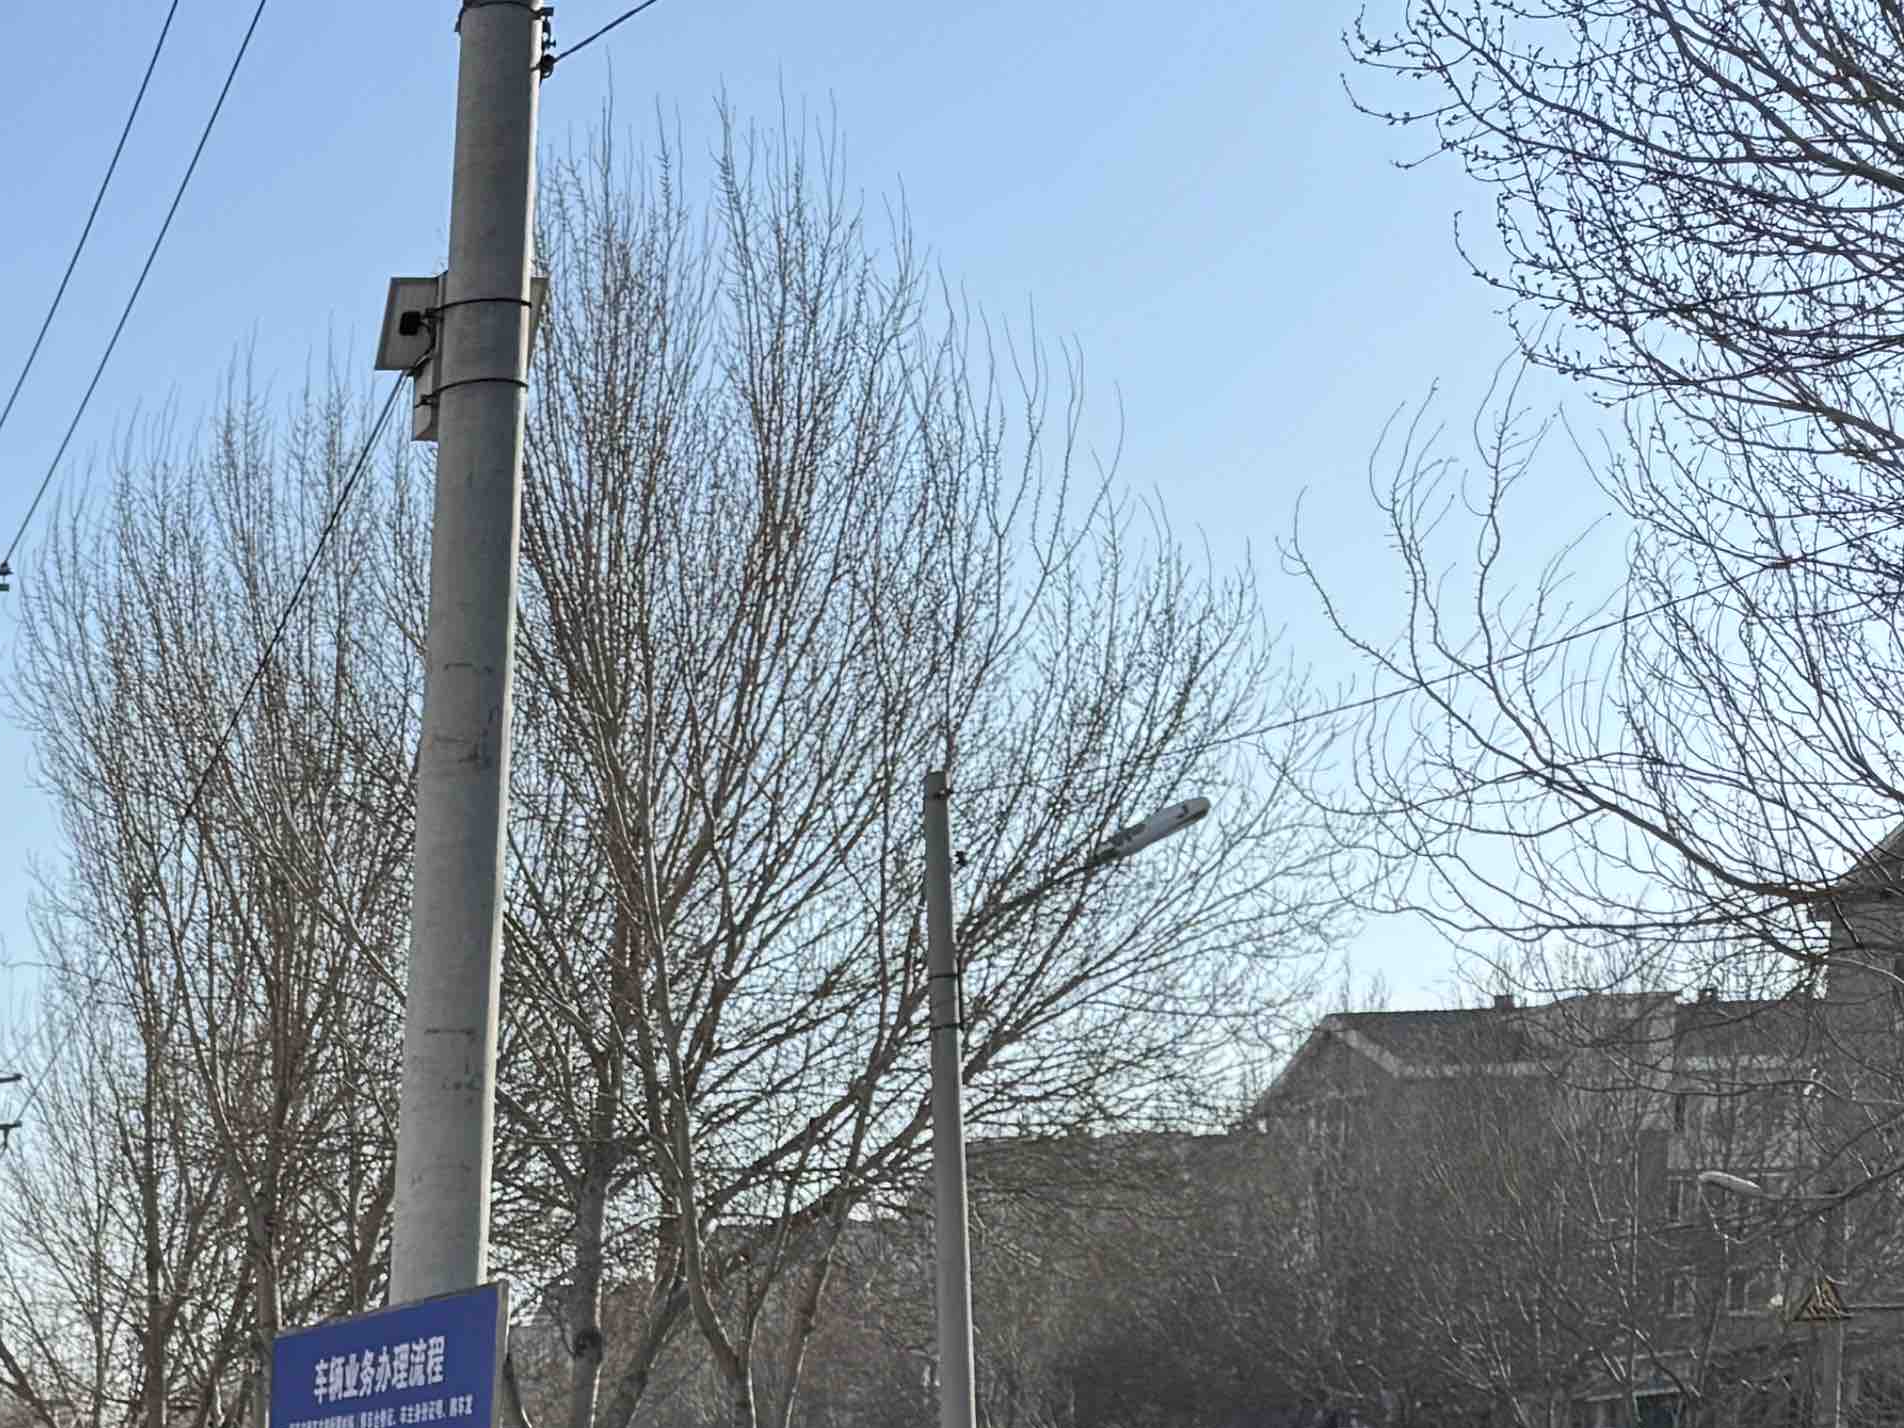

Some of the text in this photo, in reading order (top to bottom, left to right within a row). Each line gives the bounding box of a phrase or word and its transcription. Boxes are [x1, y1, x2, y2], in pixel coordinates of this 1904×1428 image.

[313, 1336, 446, 1404] 车辆业务办理流程
